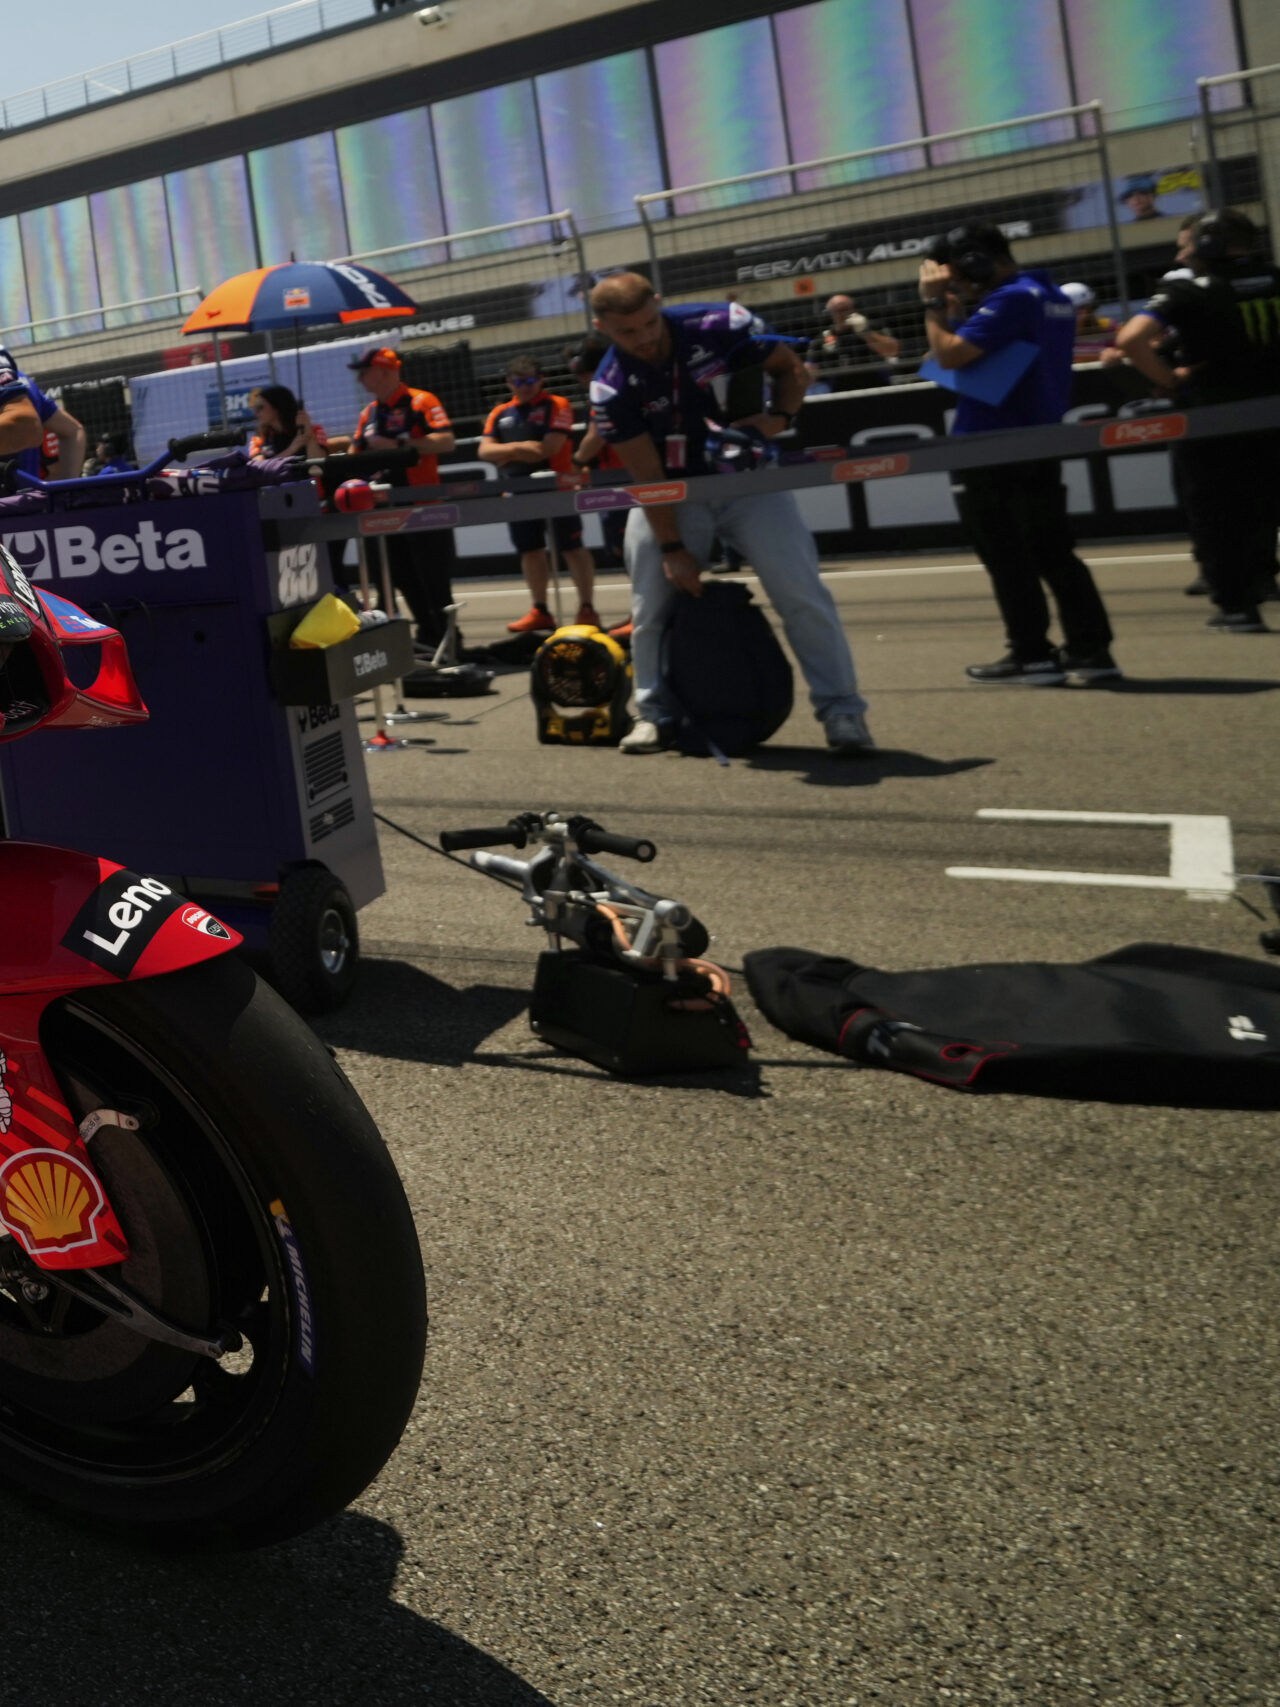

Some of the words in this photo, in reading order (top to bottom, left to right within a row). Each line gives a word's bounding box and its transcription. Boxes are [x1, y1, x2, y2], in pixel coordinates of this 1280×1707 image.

[54, 521, 207, 579] Beta
[362, 650, 388, 673] Beta
[83, 875, 172, 956] Leno
[285, 1241, 313, 1365] MICHELIN
